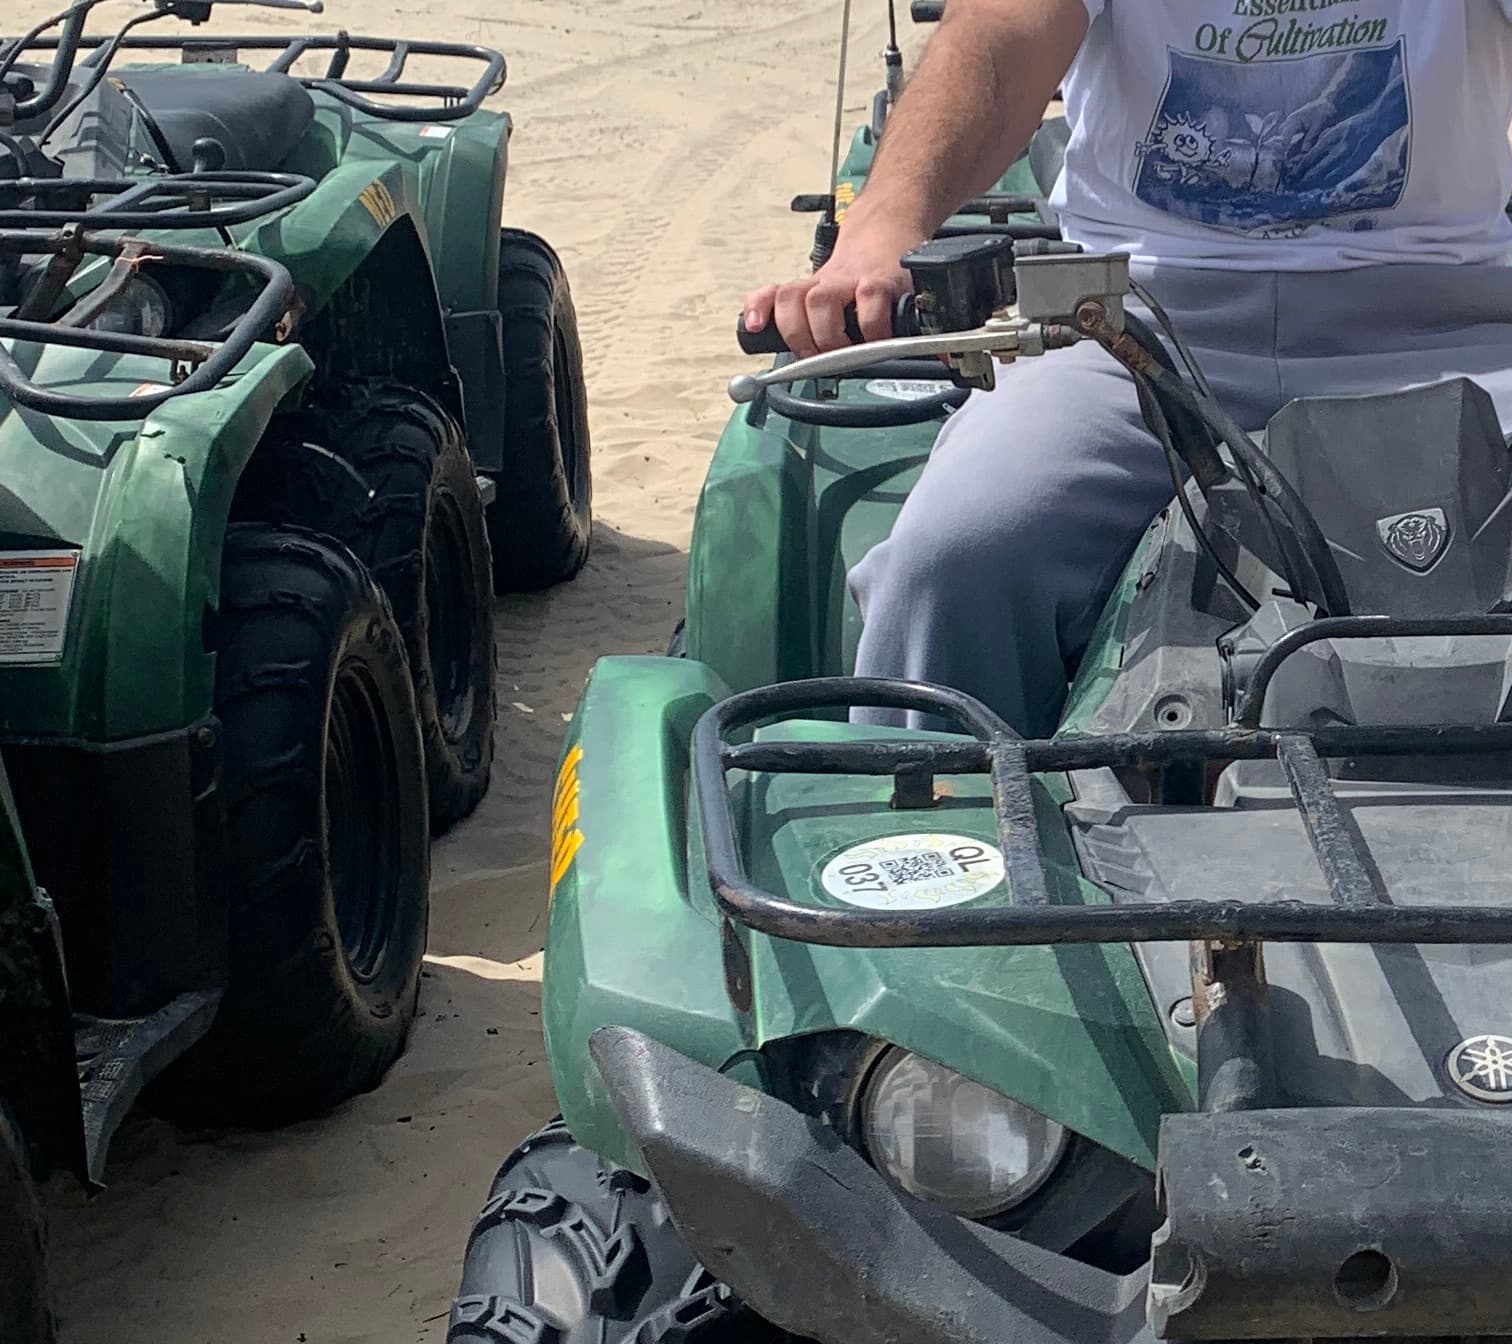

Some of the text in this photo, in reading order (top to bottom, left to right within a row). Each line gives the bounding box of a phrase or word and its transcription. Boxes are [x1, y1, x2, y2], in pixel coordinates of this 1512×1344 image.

[1195, 14, 1387, 63] Of Cultivation
[949, 845, 991, 873] QL
[838, 863, 888, 892] 037
